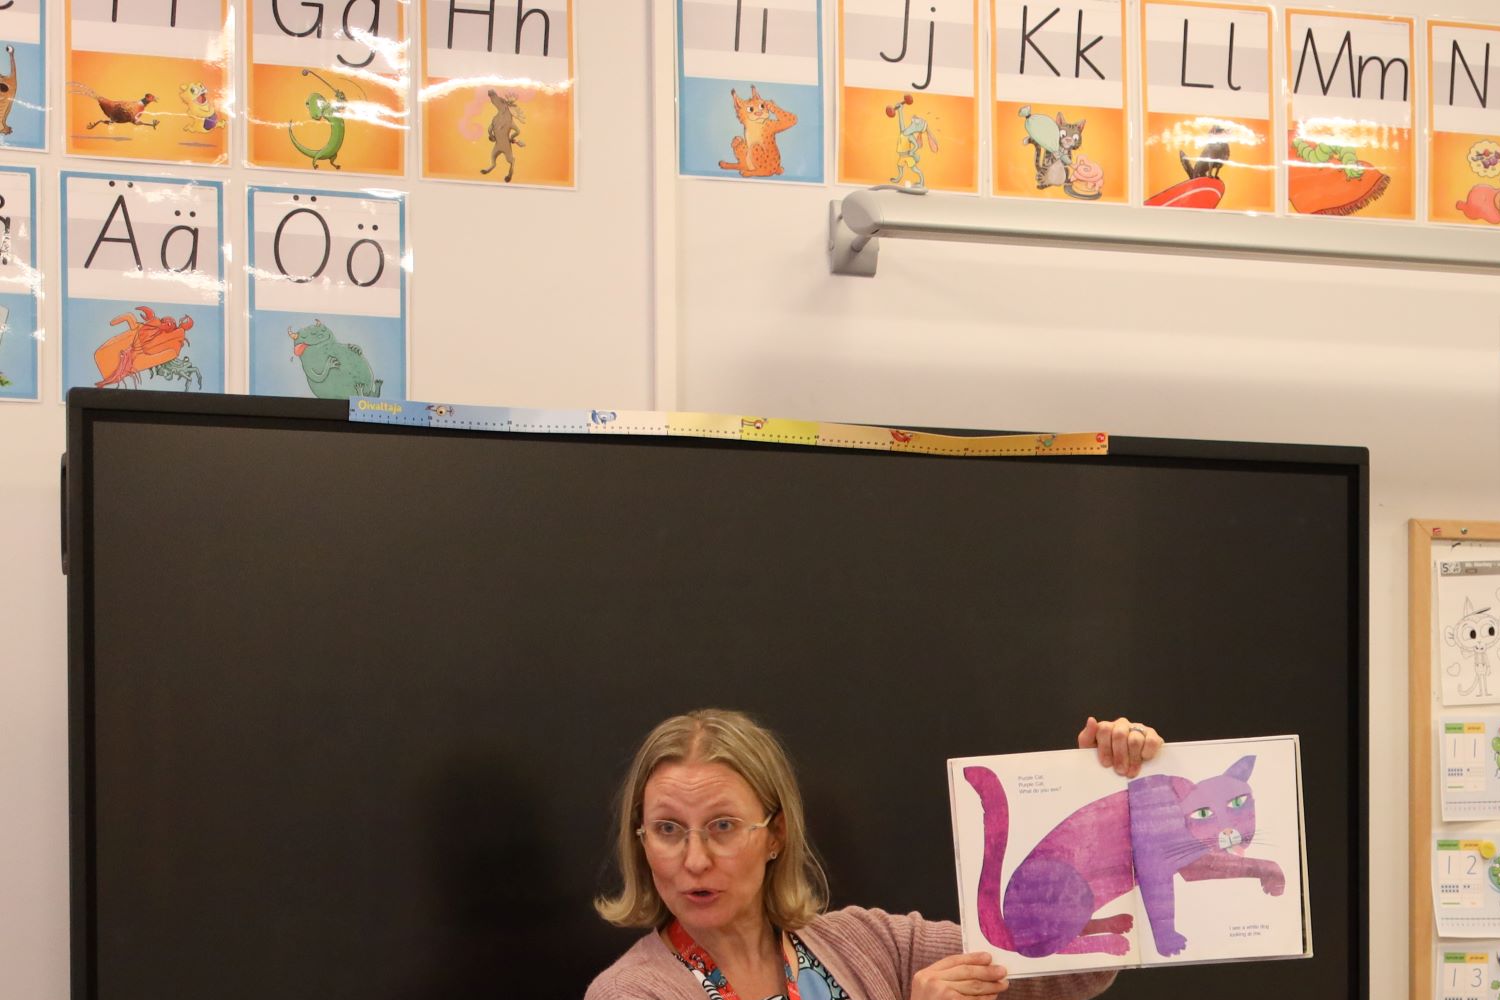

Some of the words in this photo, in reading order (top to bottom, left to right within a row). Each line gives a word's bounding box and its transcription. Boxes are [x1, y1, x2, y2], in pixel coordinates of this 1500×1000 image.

[879, 0, 937, 90] Jj
[1018, 4, 1107, 81] Kk
[1180, 18, 1242, 92] Ll
[1293, 27, 1410, 102] Mm
[84, 180, 200, 273] Ää
[273, 194, 385, 288] Öö
